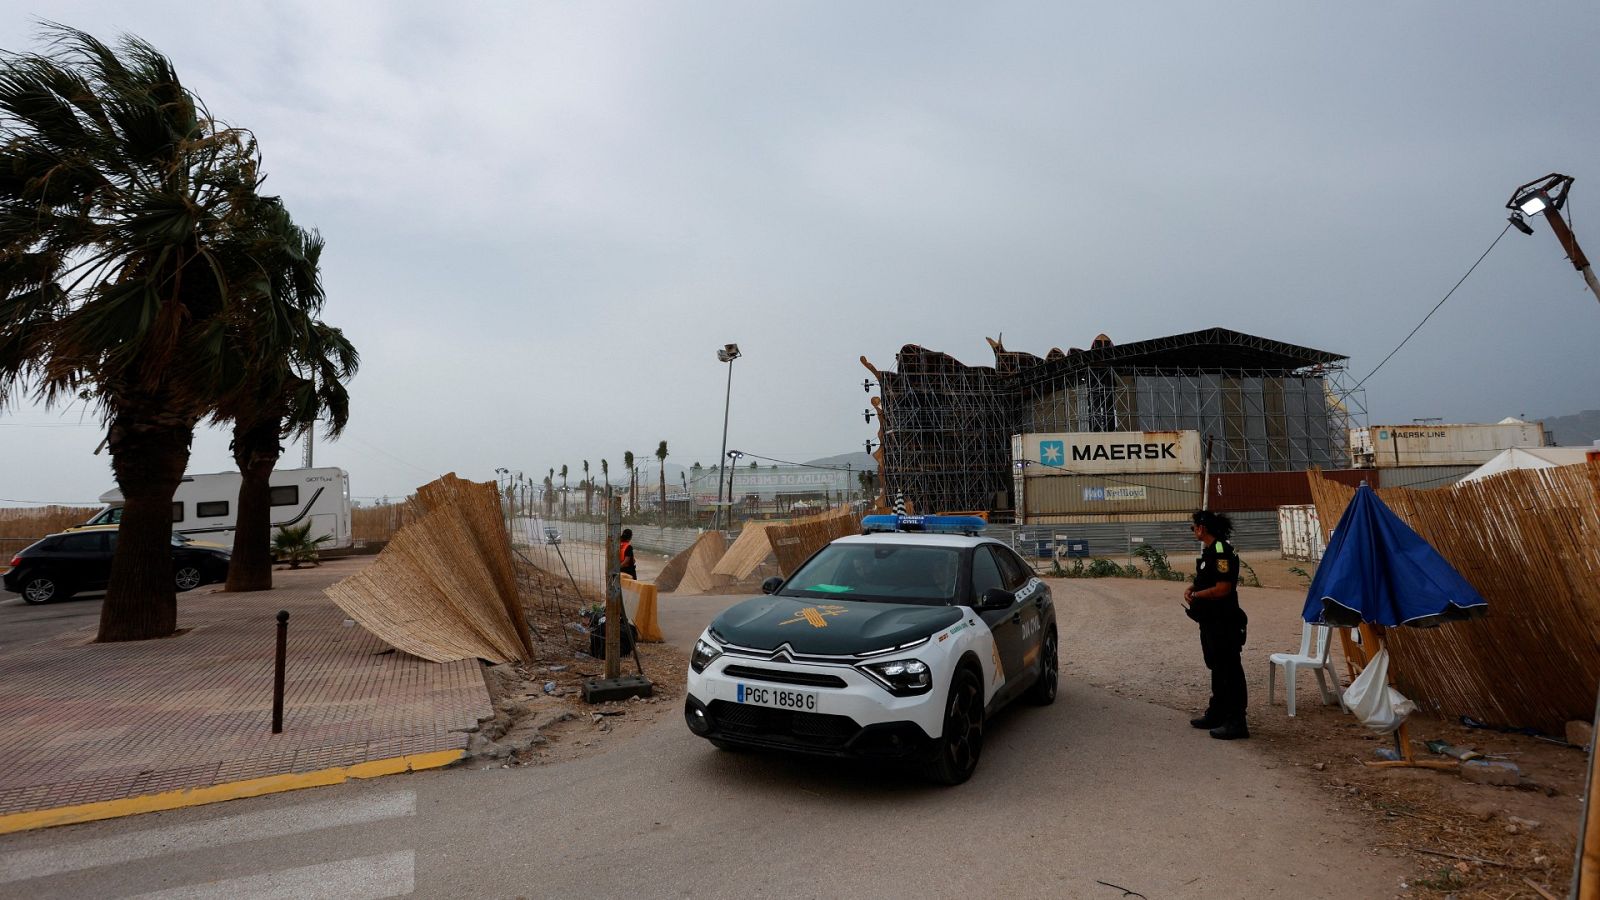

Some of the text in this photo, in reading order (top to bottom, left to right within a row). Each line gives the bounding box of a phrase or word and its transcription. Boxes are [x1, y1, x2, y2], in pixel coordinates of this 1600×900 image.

[1390, 431, 1425, 439] MAERSK
[1072, 442, 1176, 461] MAERSK
[745, 687, 815, 710] PGC 1858 G
